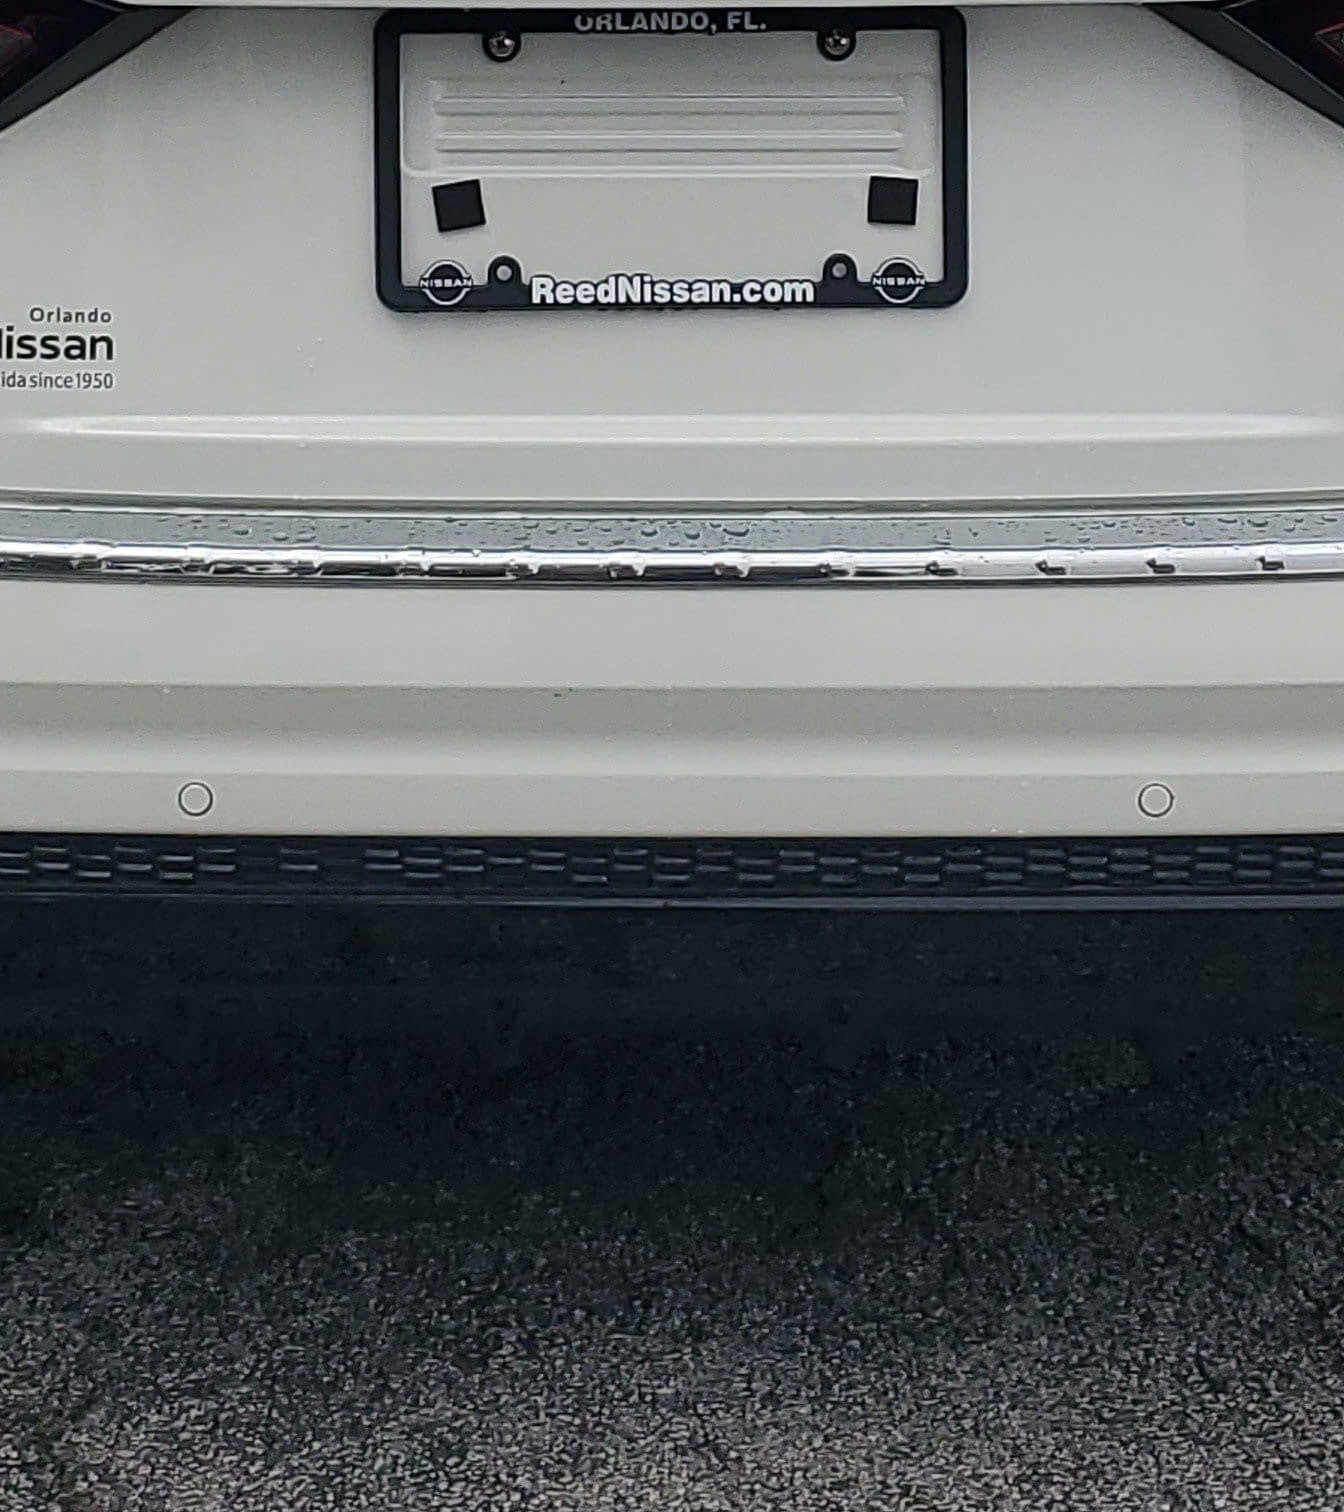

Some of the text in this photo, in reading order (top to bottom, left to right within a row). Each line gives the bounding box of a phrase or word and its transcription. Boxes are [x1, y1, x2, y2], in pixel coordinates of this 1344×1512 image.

[727, 11, 767, 31] FL.
[420, 278, 473, 288] NISSAN
[530, 273, 815, 305] ReedNissan.com
[872, 276, 925, 286] NISSAN
[29, 306, 113, 324] Orlando
[76, 372, 114, 390] 1950
